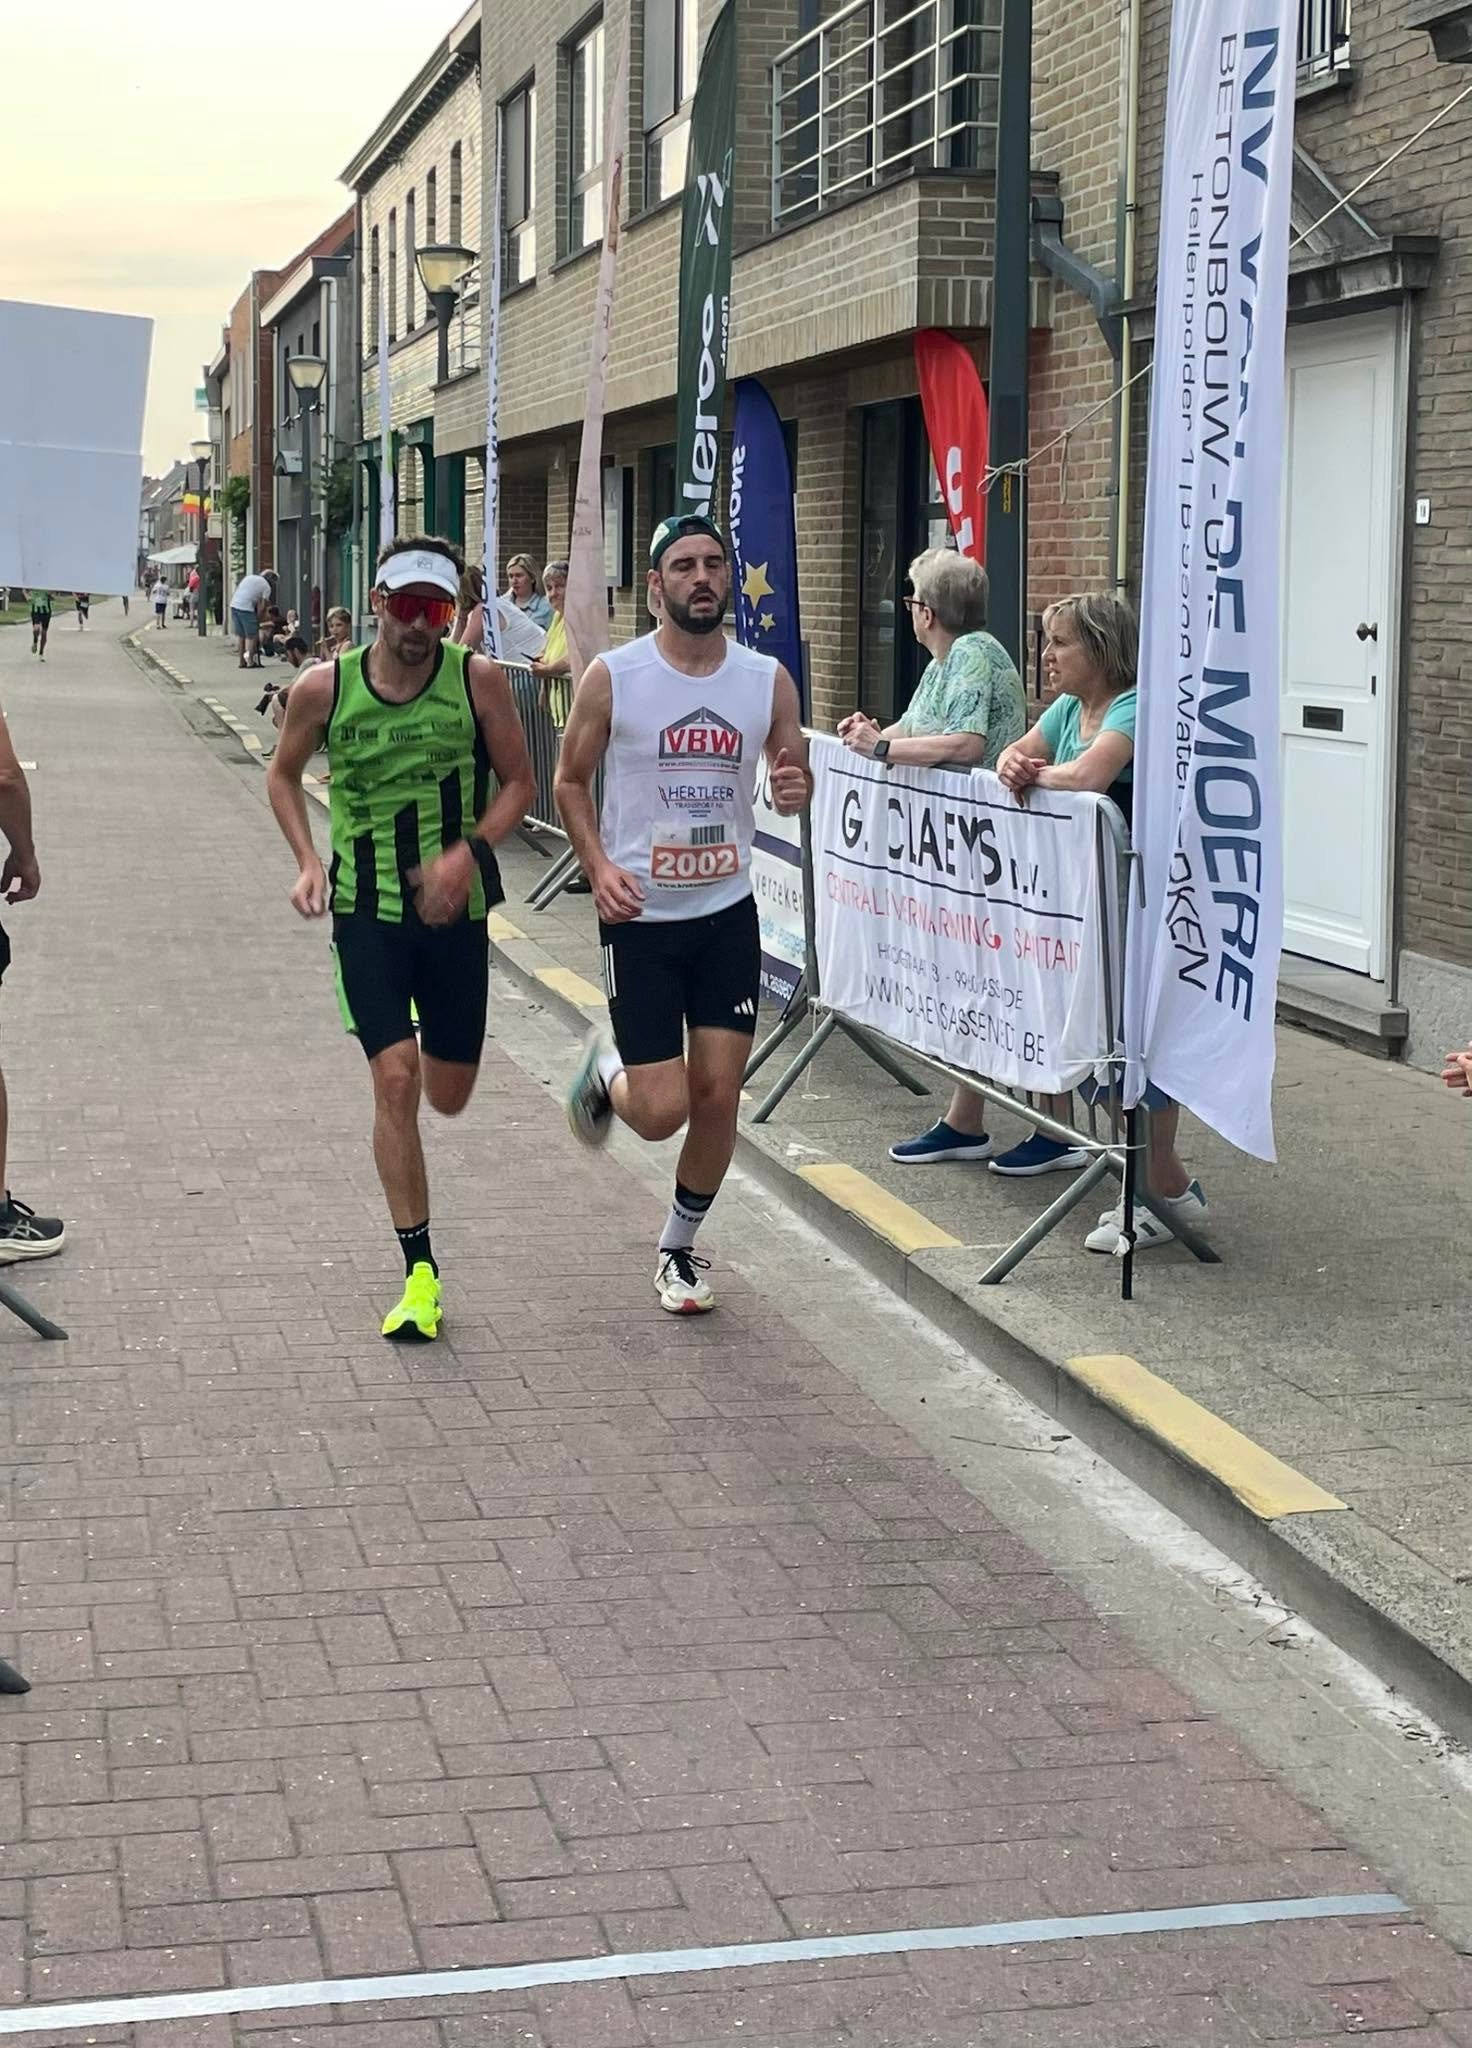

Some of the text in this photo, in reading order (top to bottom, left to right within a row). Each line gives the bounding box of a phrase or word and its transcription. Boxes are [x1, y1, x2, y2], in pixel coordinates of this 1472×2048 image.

[1241, 27, 1279, 188] NV
[1181, 173, 1204, 432] Hellenpolder
[1202, 33, 1238, 467] BETONBOUW
[682, 292, 718, 518] leroo
[666, 728, 738, 757] VBW
[668, 785, 735, 800] HERTLEER
[842, 789, 868, 852] G.
[655, 848, 735, 878] 2002
[1194, 666, 1262, 1022] MOERE
